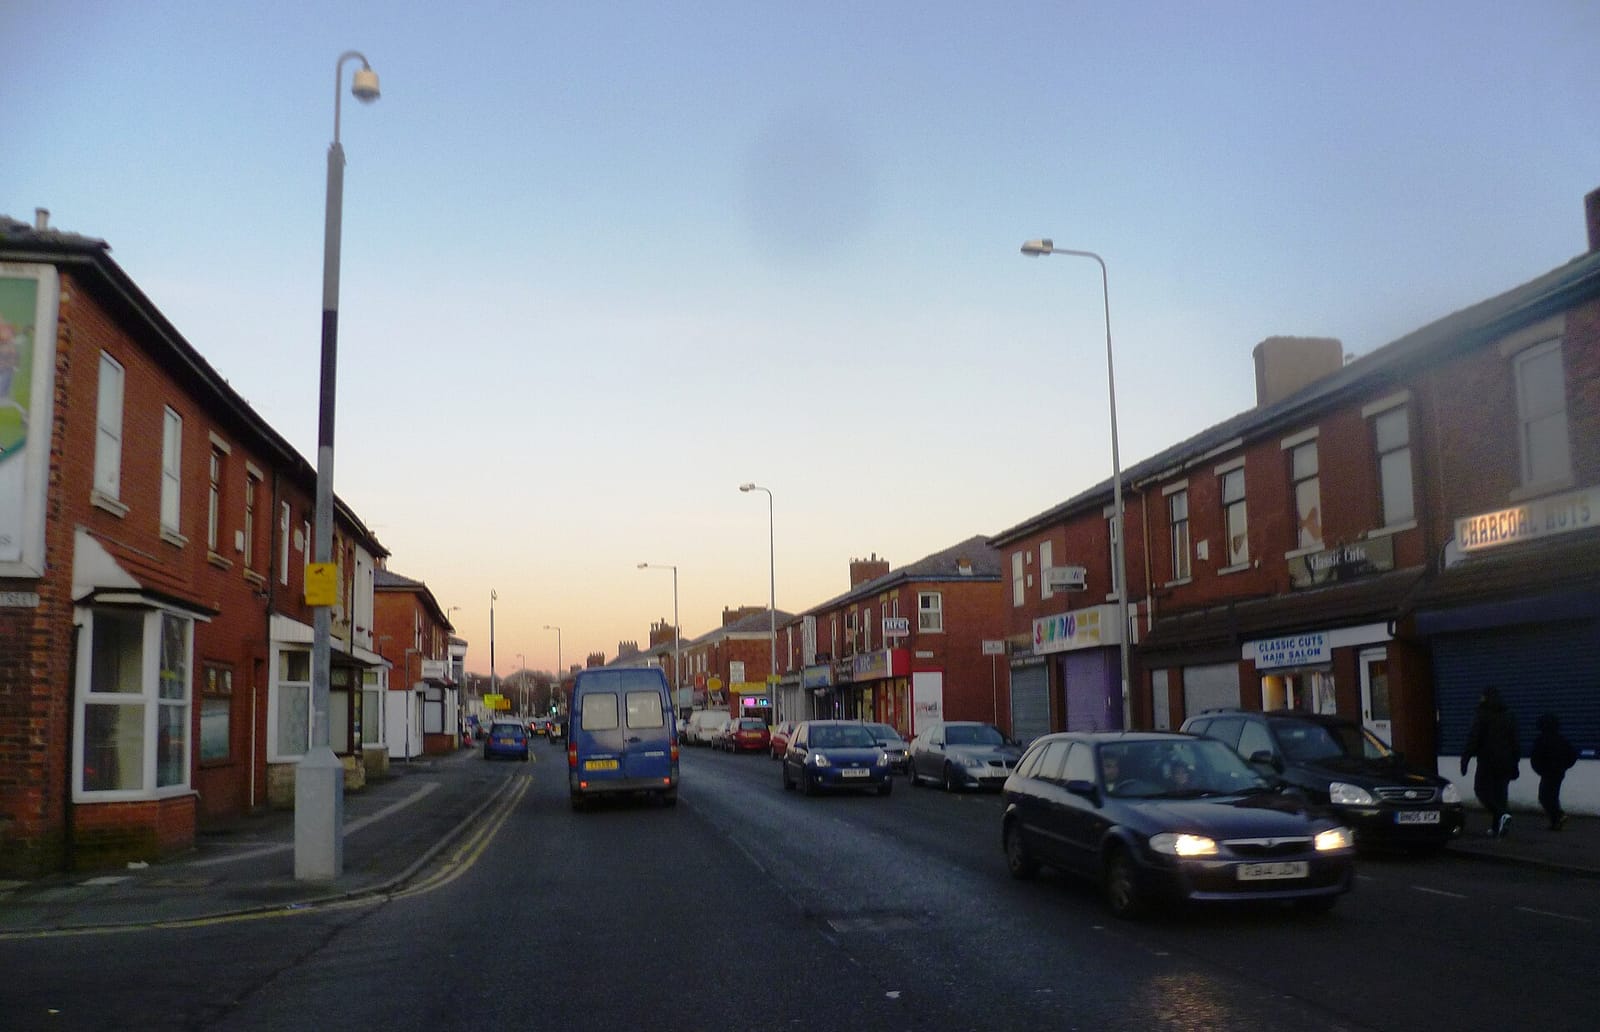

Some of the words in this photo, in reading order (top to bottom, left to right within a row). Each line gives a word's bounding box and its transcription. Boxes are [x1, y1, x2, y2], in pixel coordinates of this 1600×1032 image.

[1459, 507, 1538, 547] CHARCOAL
[1258, 637, 1296, 654] CLASSIC
[1298, 634, 1324, 649] CUTS
[1262, 651, 1285, 663] HAIR
[1288, 647, 1321, 659] SALON
